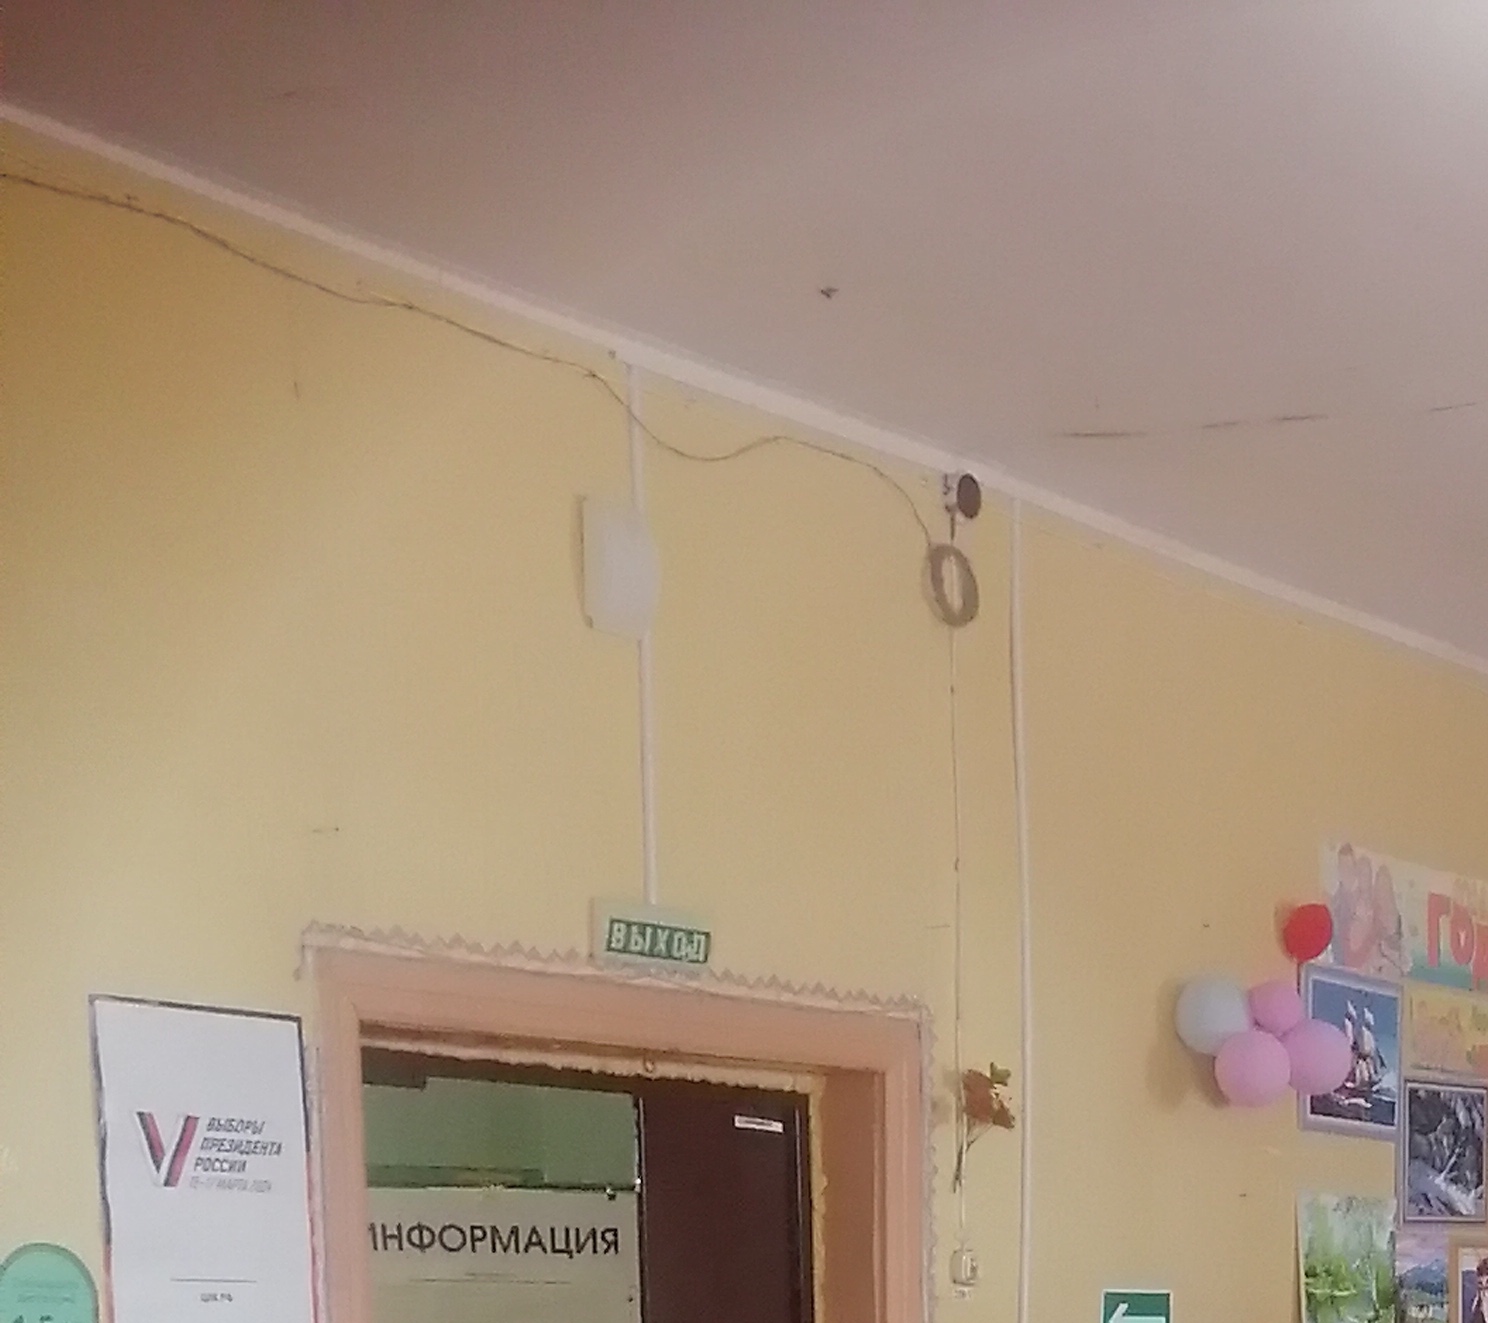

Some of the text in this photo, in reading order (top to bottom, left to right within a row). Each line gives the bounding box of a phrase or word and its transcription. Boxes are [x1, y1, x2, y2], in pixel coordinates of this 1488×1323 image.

[610, 922, 707, 962] ВЫХОД
[206, 1117, 266, 1136] ВЫБОРЫ
[200, 1136, 284, 1157] ПРЕЗИДЕНТА
[194, 1156, 248, 1173] РОССИИ
